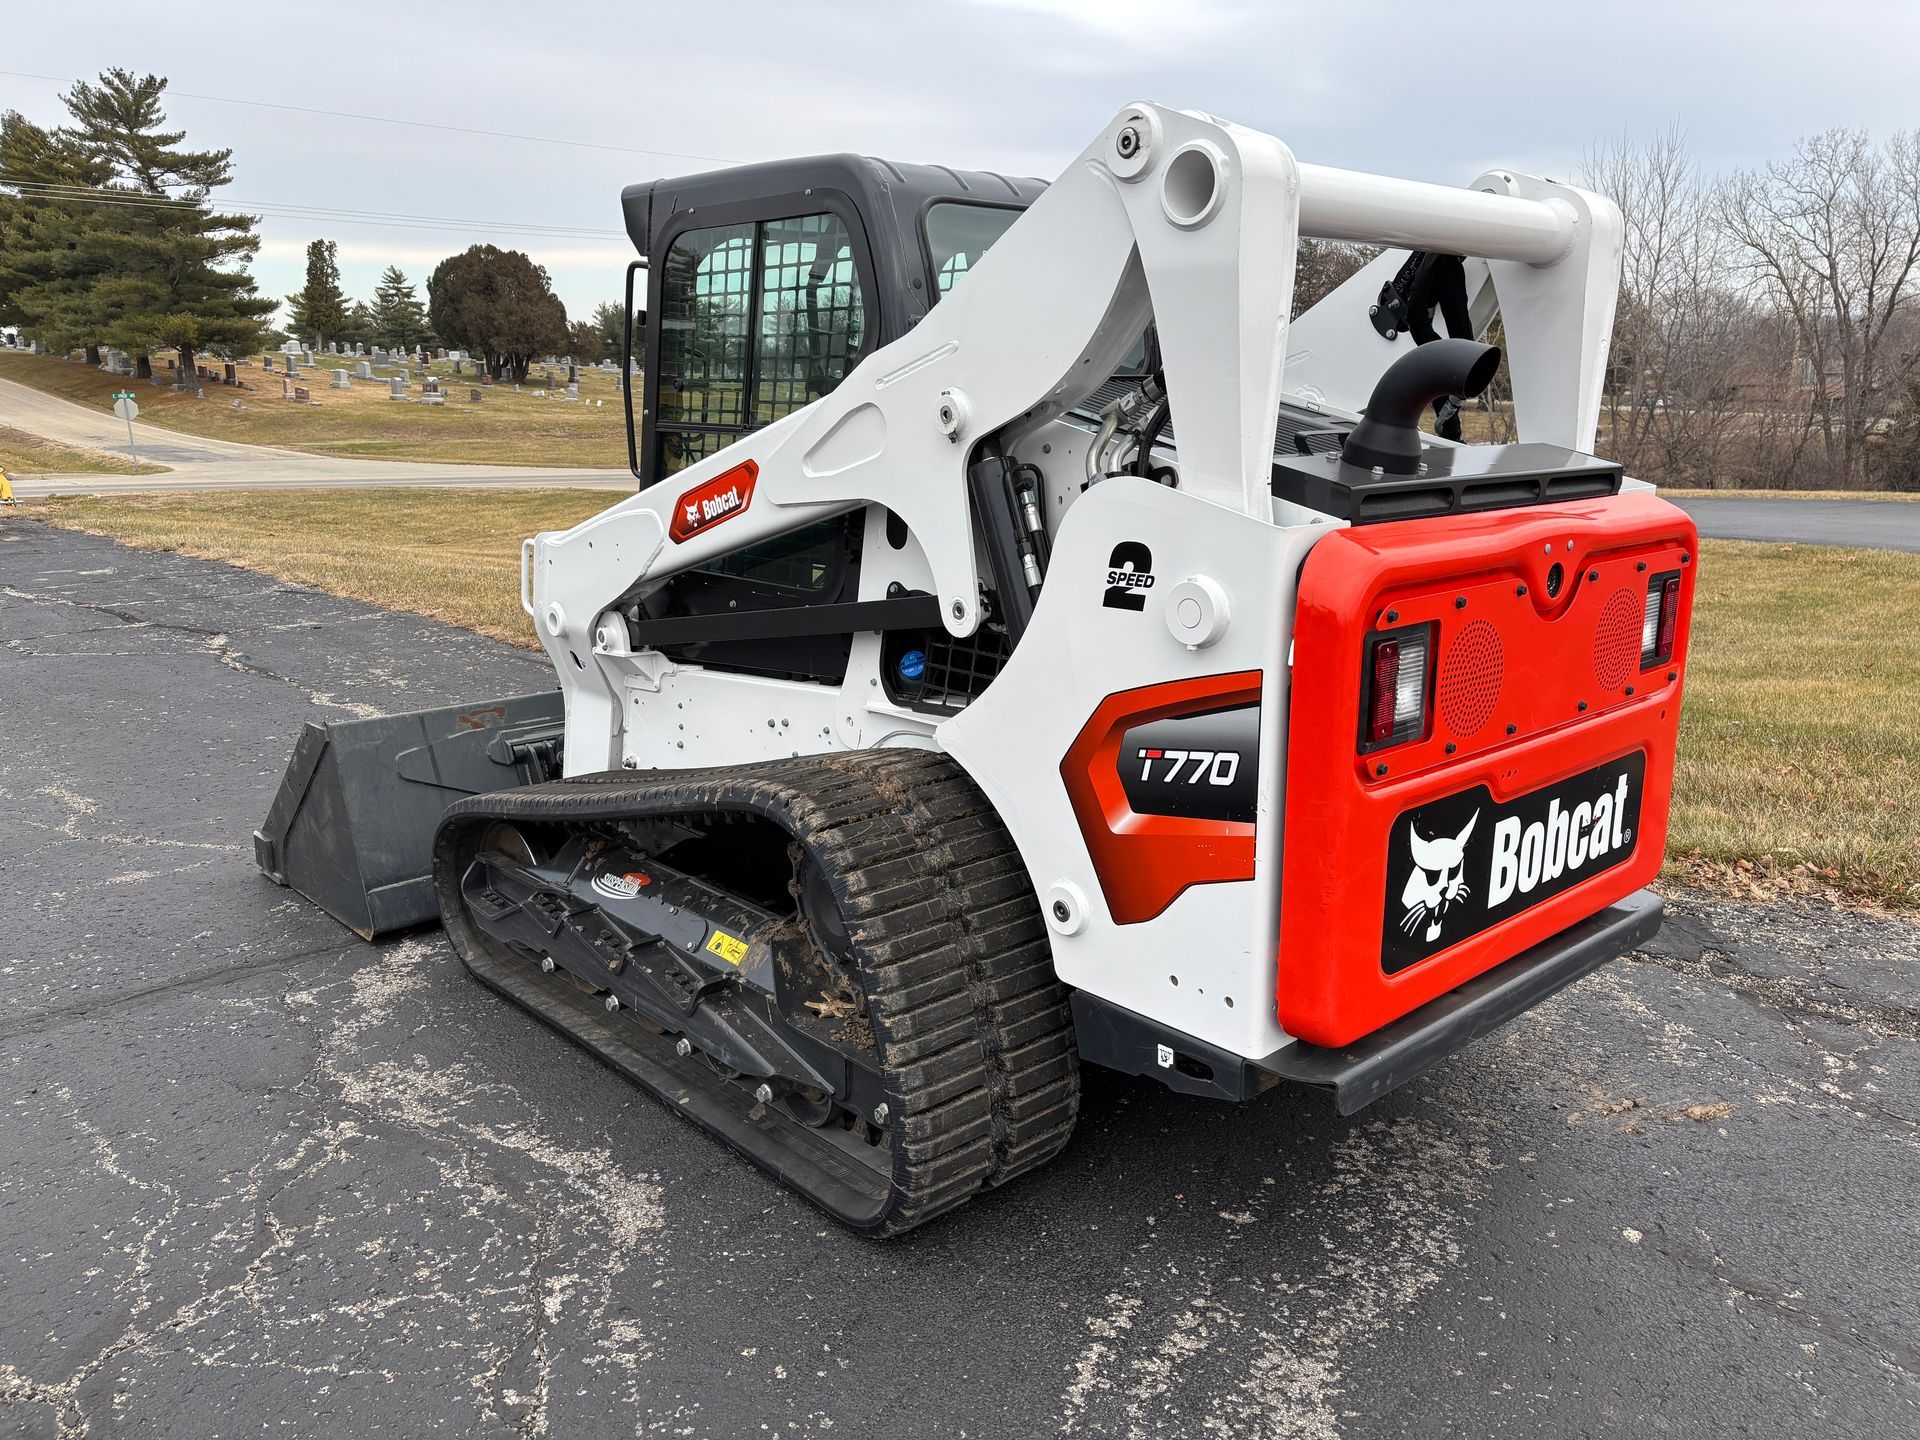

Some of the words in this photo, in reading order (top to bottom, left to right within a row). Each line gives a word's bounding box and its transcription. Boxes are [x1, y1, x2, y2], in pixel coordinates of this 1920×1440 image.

[702, 486, 740, 520] Bobcat
[1102, 541, 1153, 612] 2
[1106, 571, 1155, 589] SPEED
[1138, 749, 1240, 786] T770
[1487, 773, 1628, 909] Bobcat
[601, 873, 641, 896] SUSPENSION
